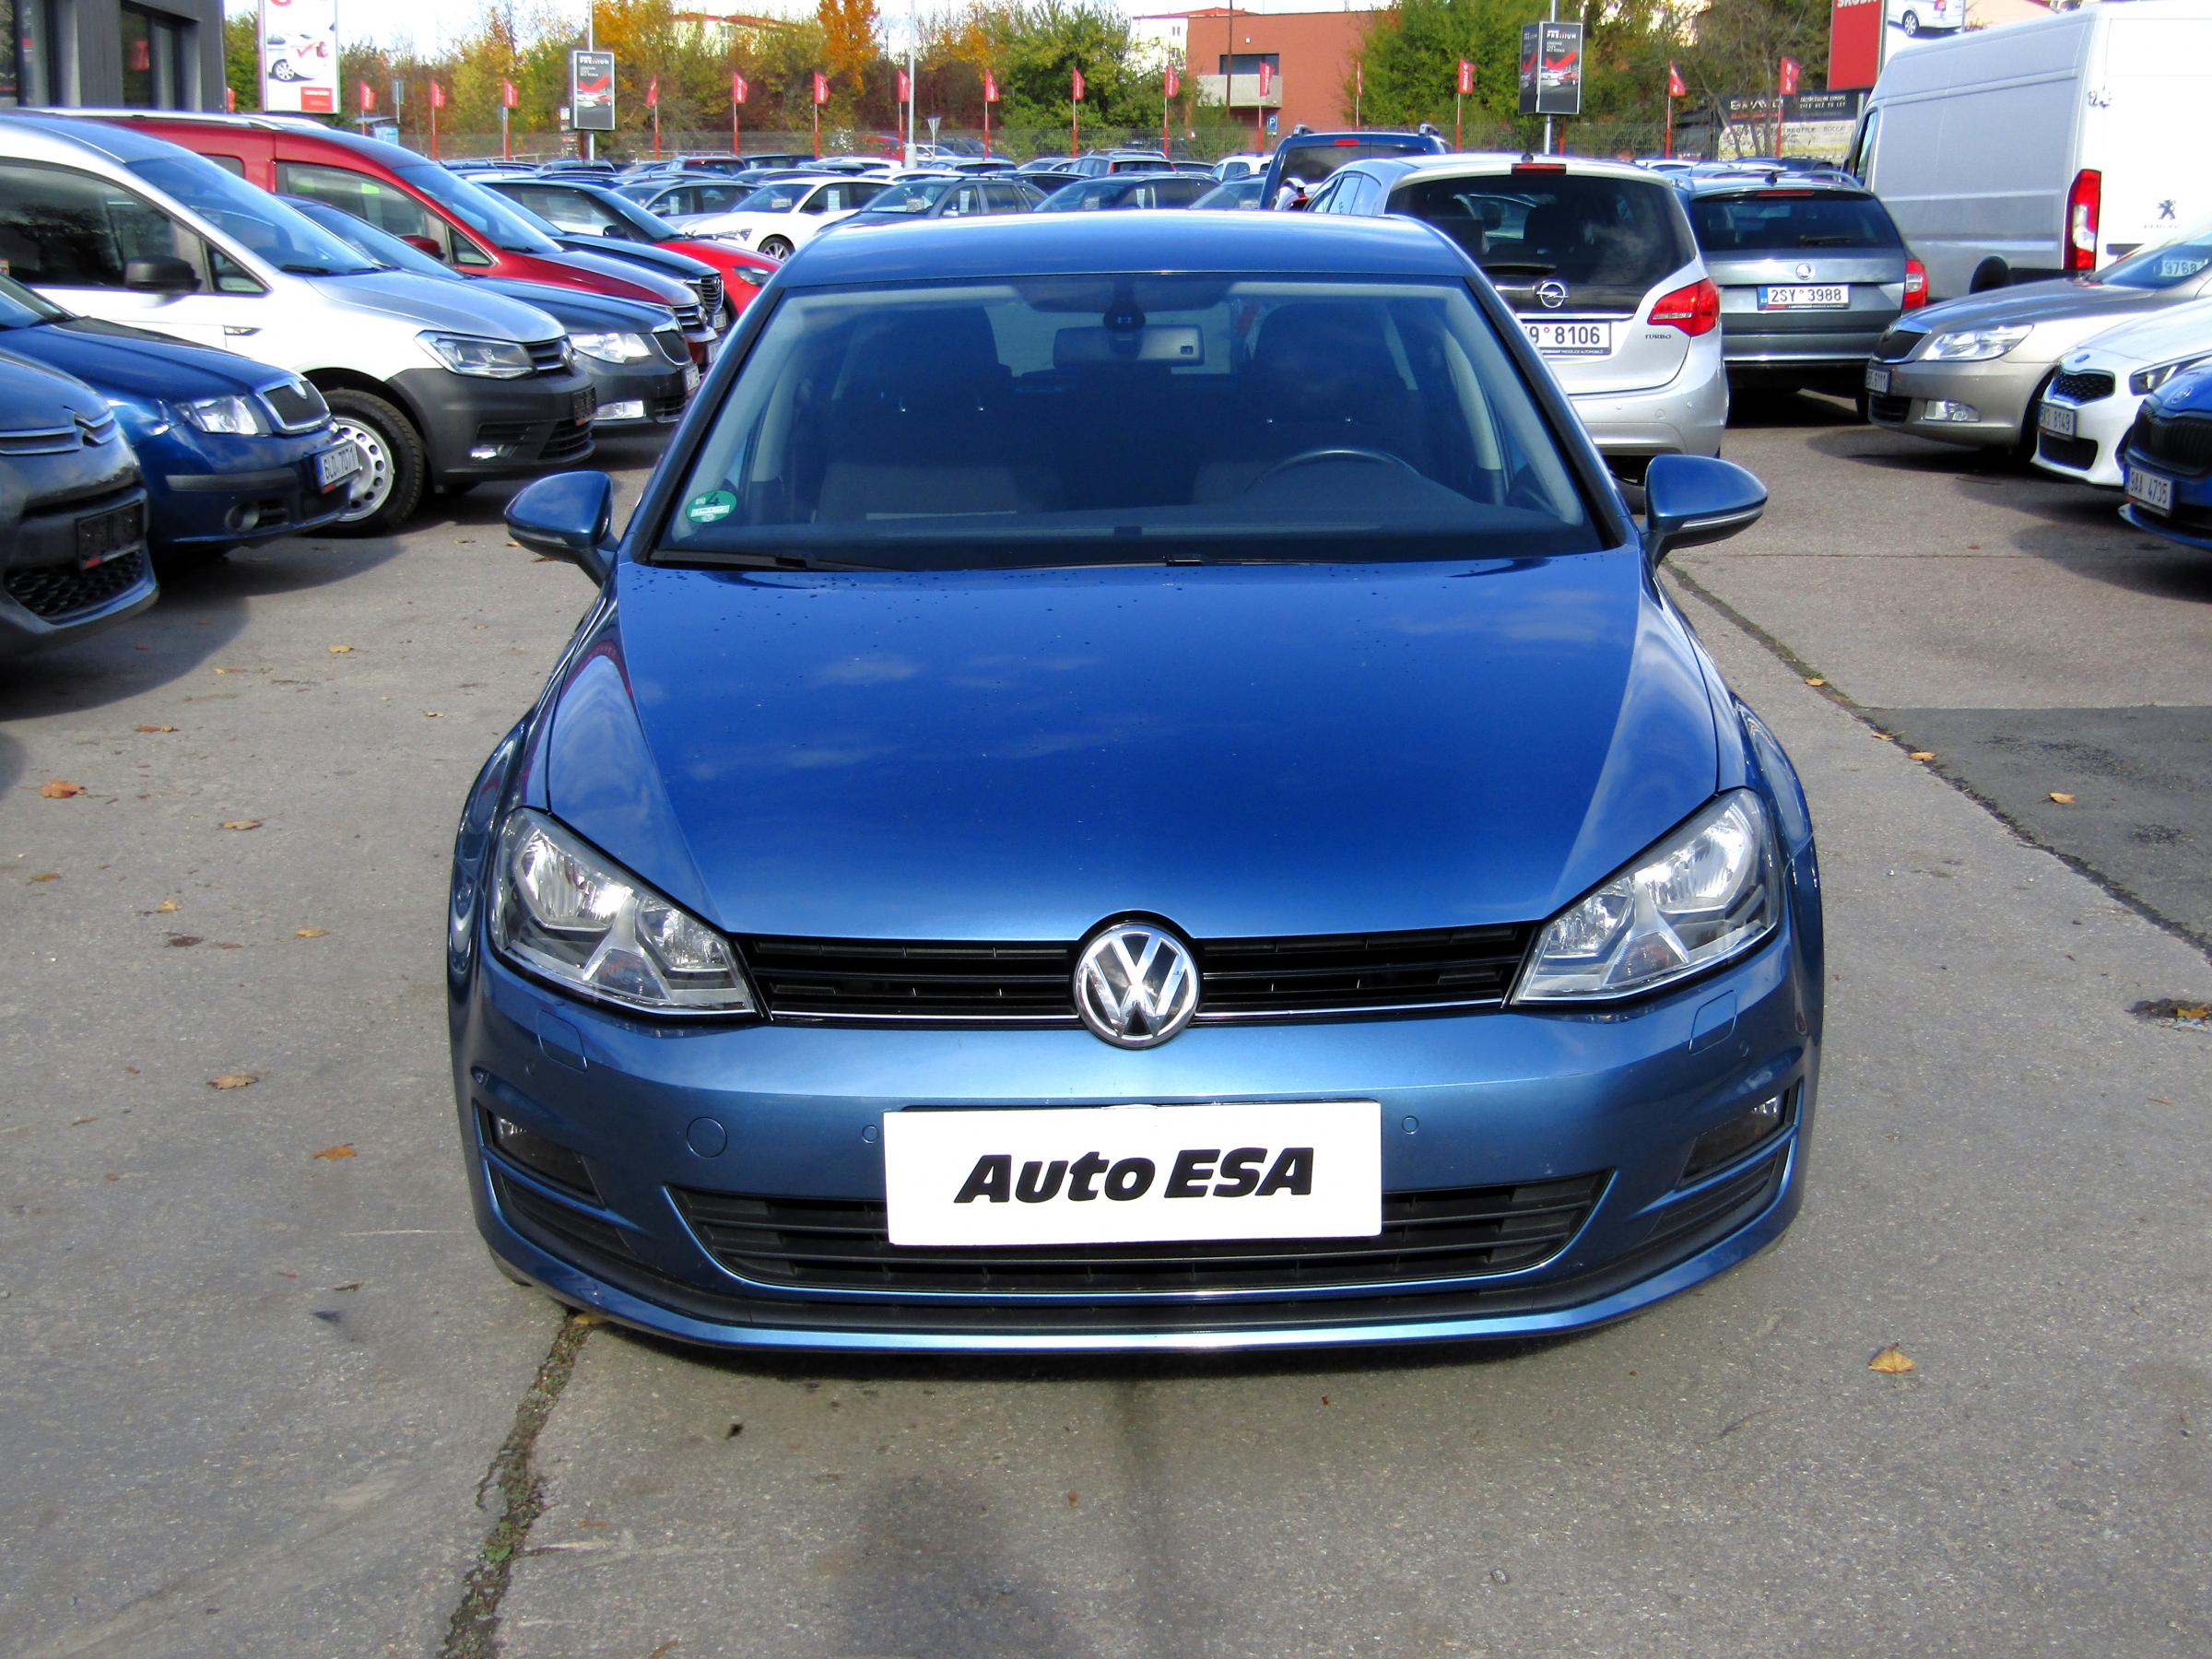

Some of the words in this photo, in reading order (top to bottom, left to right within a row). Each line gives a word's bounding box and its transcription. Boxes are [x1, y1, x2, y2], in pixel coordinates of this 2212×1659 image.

[1771, 288, 1797, 302] 2SY
[1807, 288, 1841, 302] 3988
[1524, 325, 1540, 345] 9
[1555, 325, 1600, 345] 8106
[953, 1151, 1156, 1204] Auto
[1163, 1147, 1314, 1198] ESA
